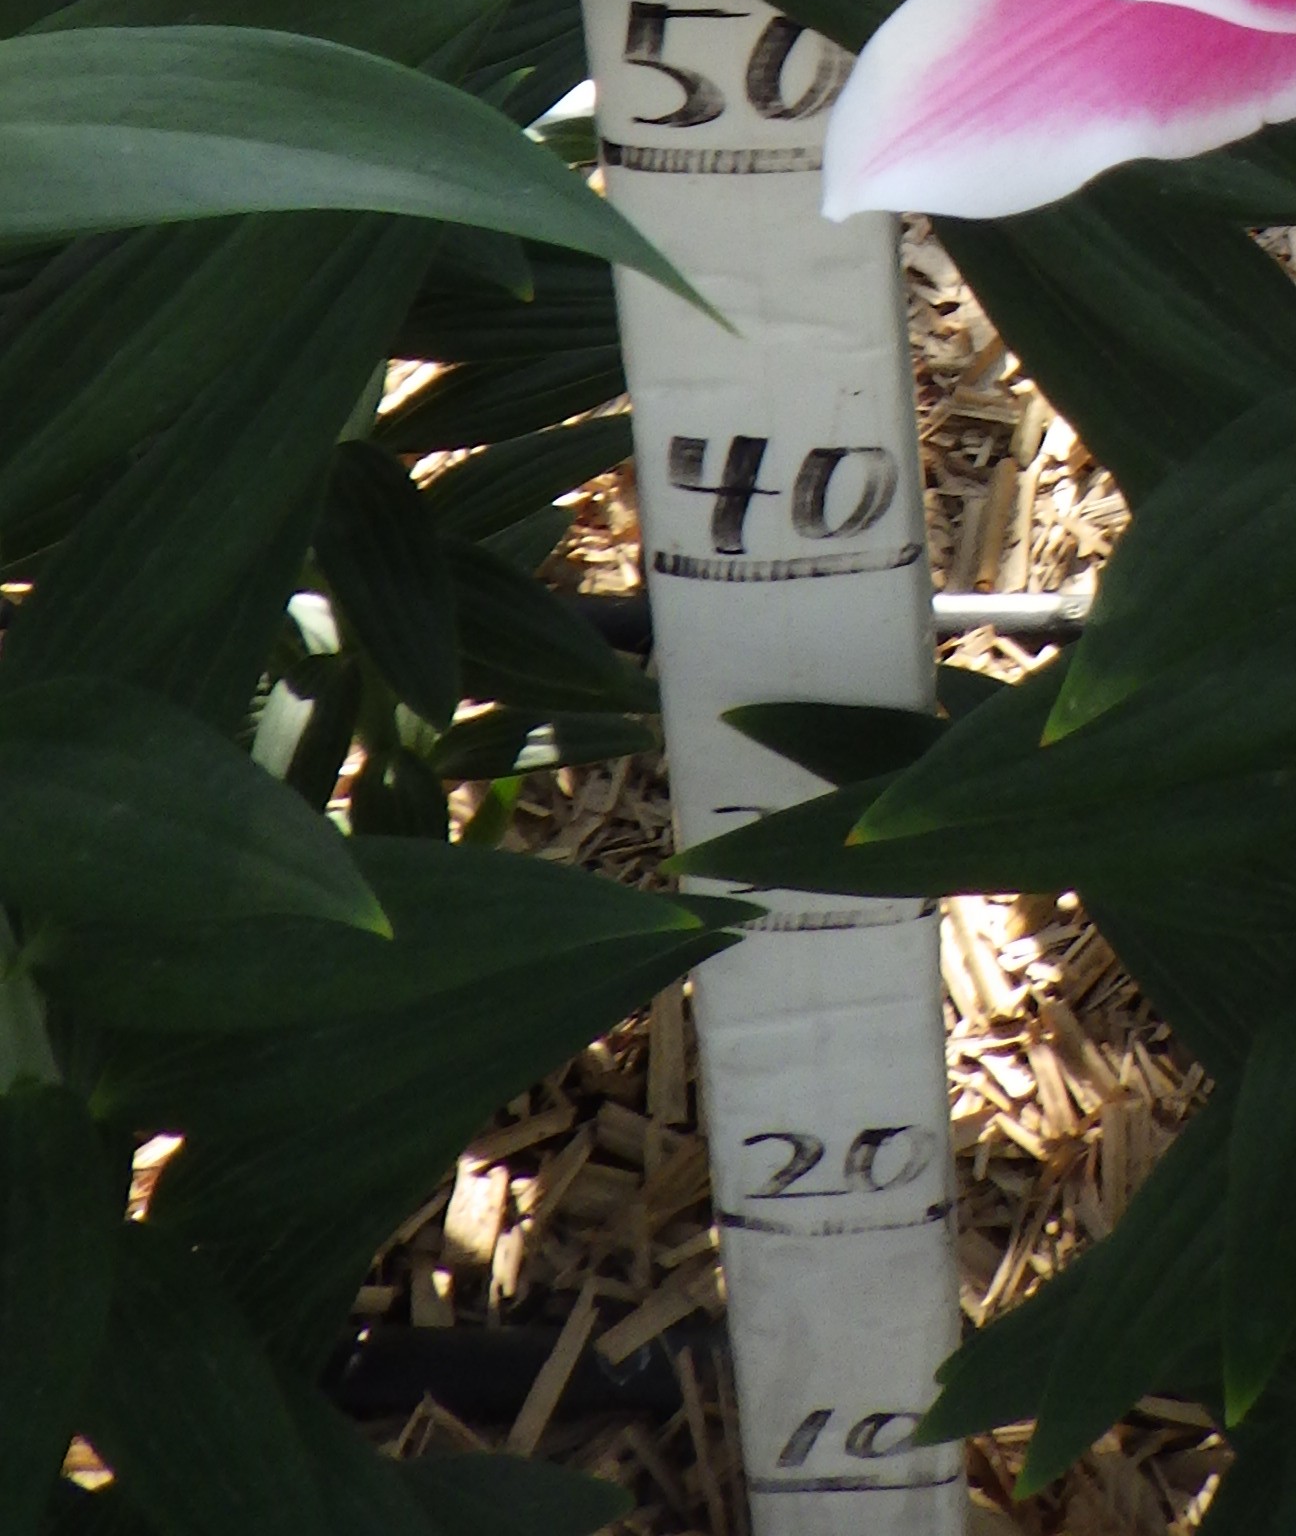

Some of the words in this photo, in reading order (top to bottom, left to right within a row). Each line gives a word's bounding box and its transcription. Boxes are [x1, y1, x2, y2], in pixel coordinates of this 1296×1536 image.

[622, 0, 856, 127] 50
[667, 434, 898, 555] 40
[743, 1124, 938, 1199] 20
[775, 1408, 926, 1469] 10
